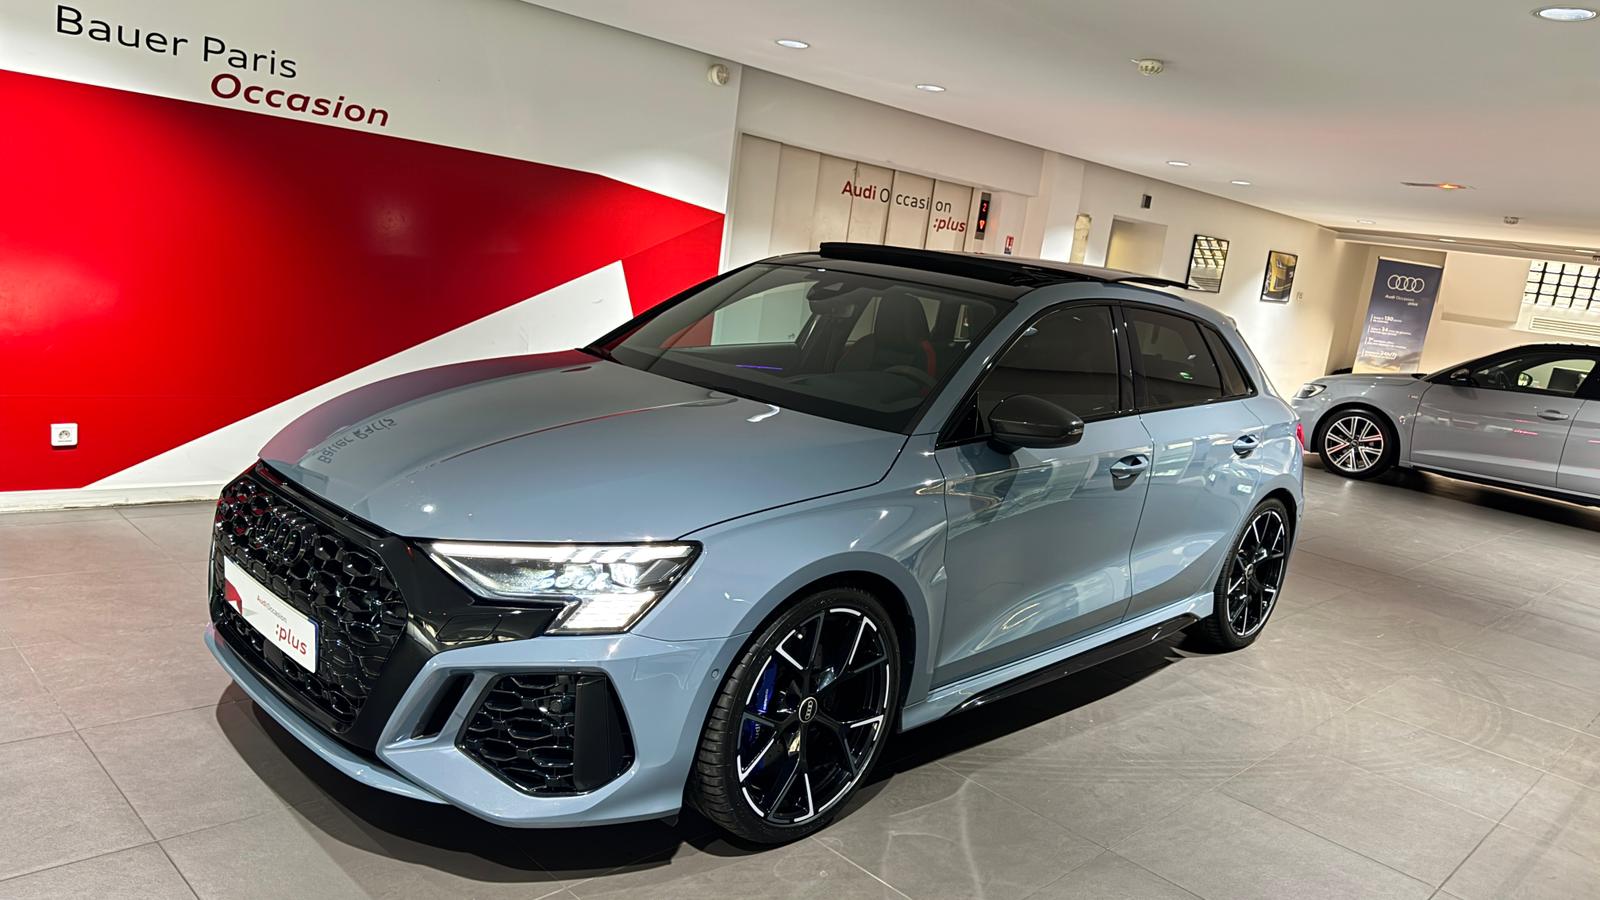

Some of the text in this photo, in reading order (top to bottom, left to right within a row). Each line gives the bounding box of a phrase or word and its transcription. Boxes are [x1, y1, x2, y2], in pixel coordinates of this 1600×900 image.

[56, 4, 297, 78] Bauer Paris
[210, 73, 389, 127] Occasion
[842, 181, 877, 201] Audi
[275, 623, 308, 656] :plus
